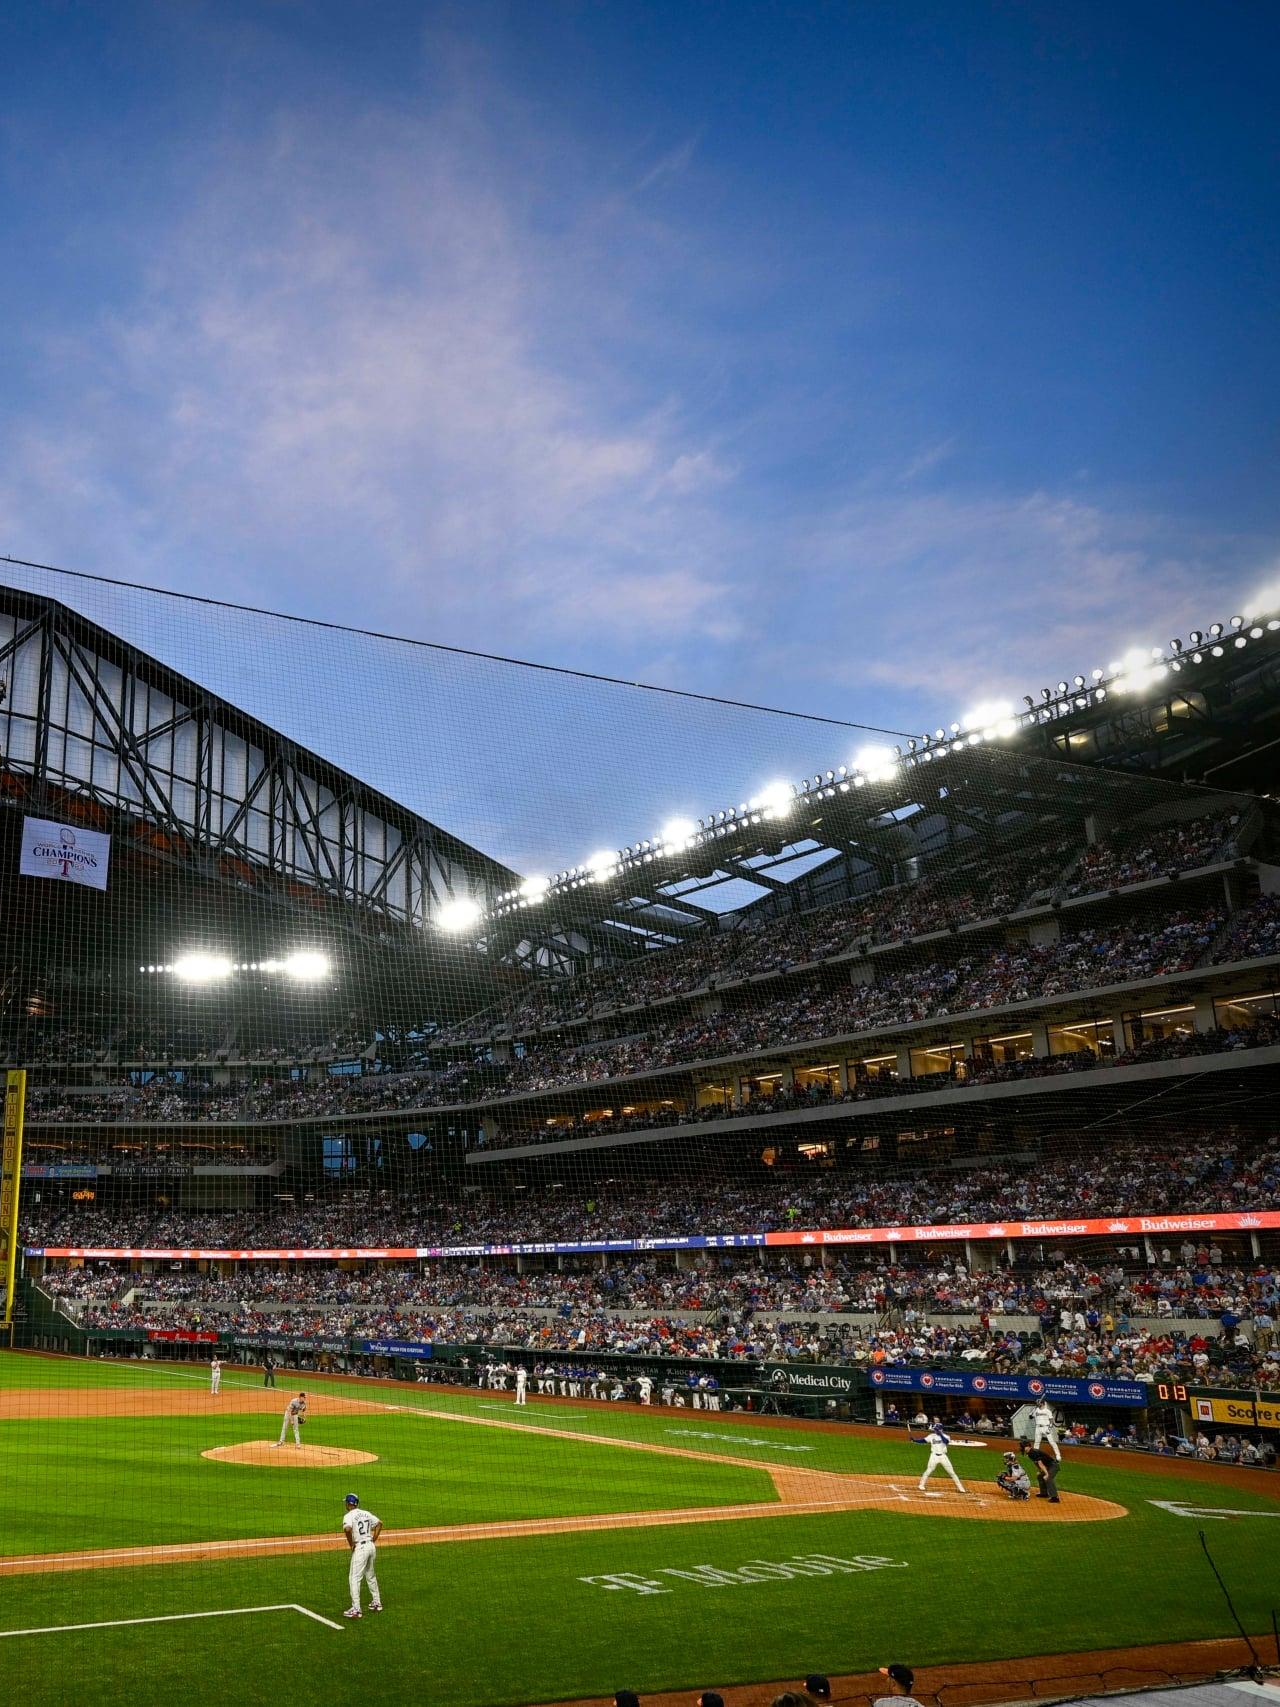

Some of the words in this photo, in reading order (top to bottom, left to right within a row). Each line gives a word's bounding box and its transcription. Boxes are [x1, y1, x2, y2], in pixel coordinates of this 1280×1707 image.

[33, 847, 98, 868] CHAMPIONS
[1022, 1223, 1087, 1236] Budweiser
[1141, 1217, 1216, 1230] Budweiser
[822, 1232, 872, 1242] Budweiser
[915, 1228, 971, 1239] Budweiser
[233, 1337, 259, 1345] American
[293, 1340, 314, 1348] American
[789, 1374, 827, 1387] Medical
[829, 1377, 852, 1390] City
[1228, 1405, 1272, 1420] Score
[358, 1520, 370, 1535] 27
[652, 1553, 909, 1587] Mobile
